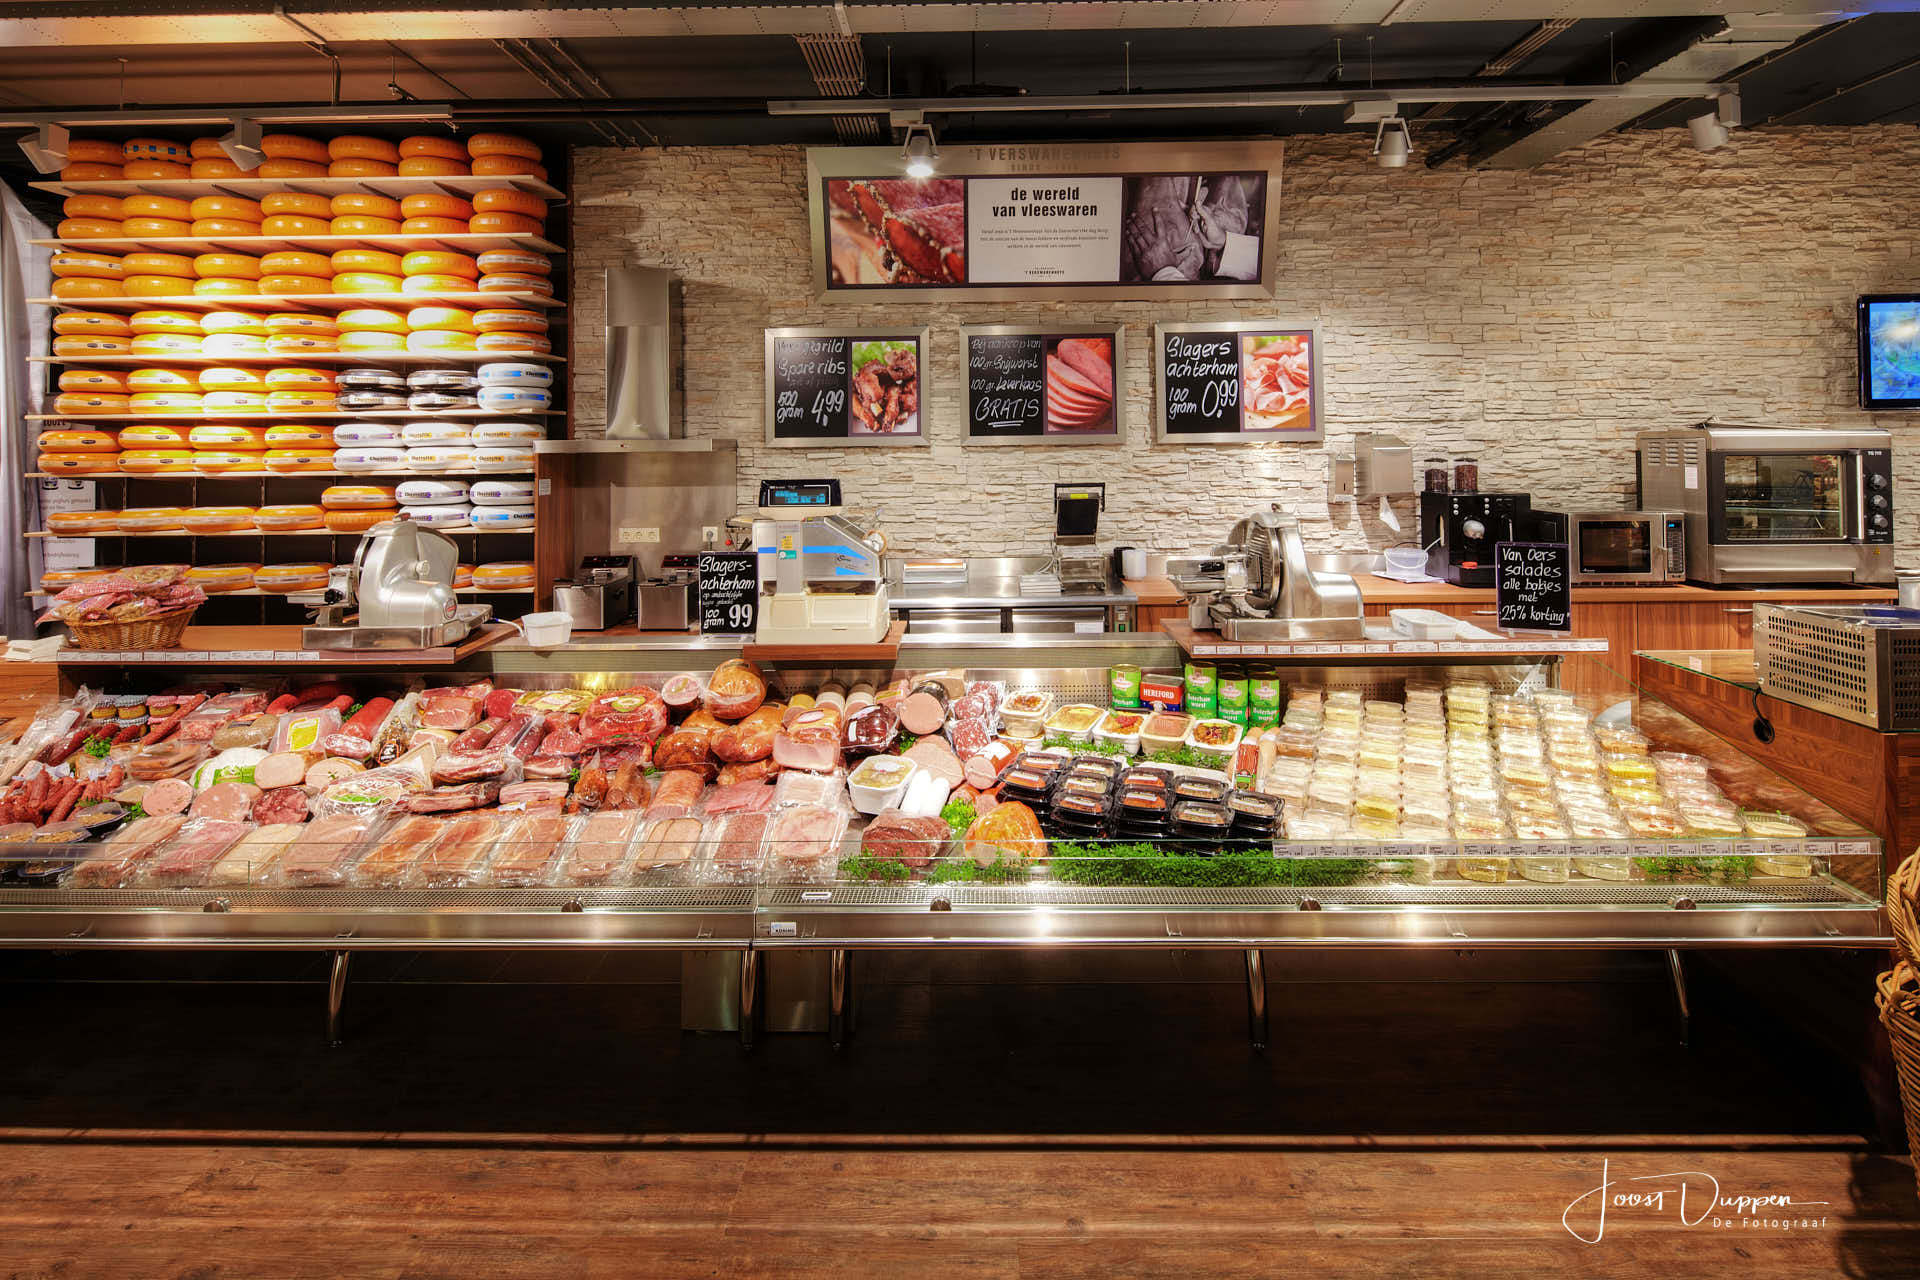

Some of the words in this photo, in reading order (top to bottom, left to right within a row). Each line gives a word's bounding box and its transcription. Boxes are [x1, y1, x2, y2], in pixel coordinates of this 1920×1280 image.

[1011, 187, 1027, 201] de
[1033, 186, 1080, 201] wereld
[992, 205, 1016, 217] van
[1022, 203, 1098, 217] vleeswaren
[1166, 336, 1232, 360] Slagers
[1166, 357, 1238, 378] achterham
[778, 390, 799, 407] 500
[1168, 386, 1190, 402] 100
[776, 407, 804, 424] gram
[975, 396, 1040, 421] GRATIS
[1168, 401, 1198, 420] gram
[1502, 547, 1523, 562] Van
[1527, 548, 1557, 562] Oers
[700, 555, 752, 577] Slagers-
[1504, 561, 1562, 578] salades
[700, 574, 756, 591] achterham
[1502, 577, 1521, 591] alle
[1525, 577, 1562, 597] bakjes
[1518, 591, 1539, 602] met
[704, 609, 720, 619] 100
[728, 603, 754, 628] 99
[1501, 604, 1527, 621] 25%
[1530, 605, 1565, 626] korting
[703, 617, 725, 630] gram
[1143, 688, 1175, 700] HEREFORD
